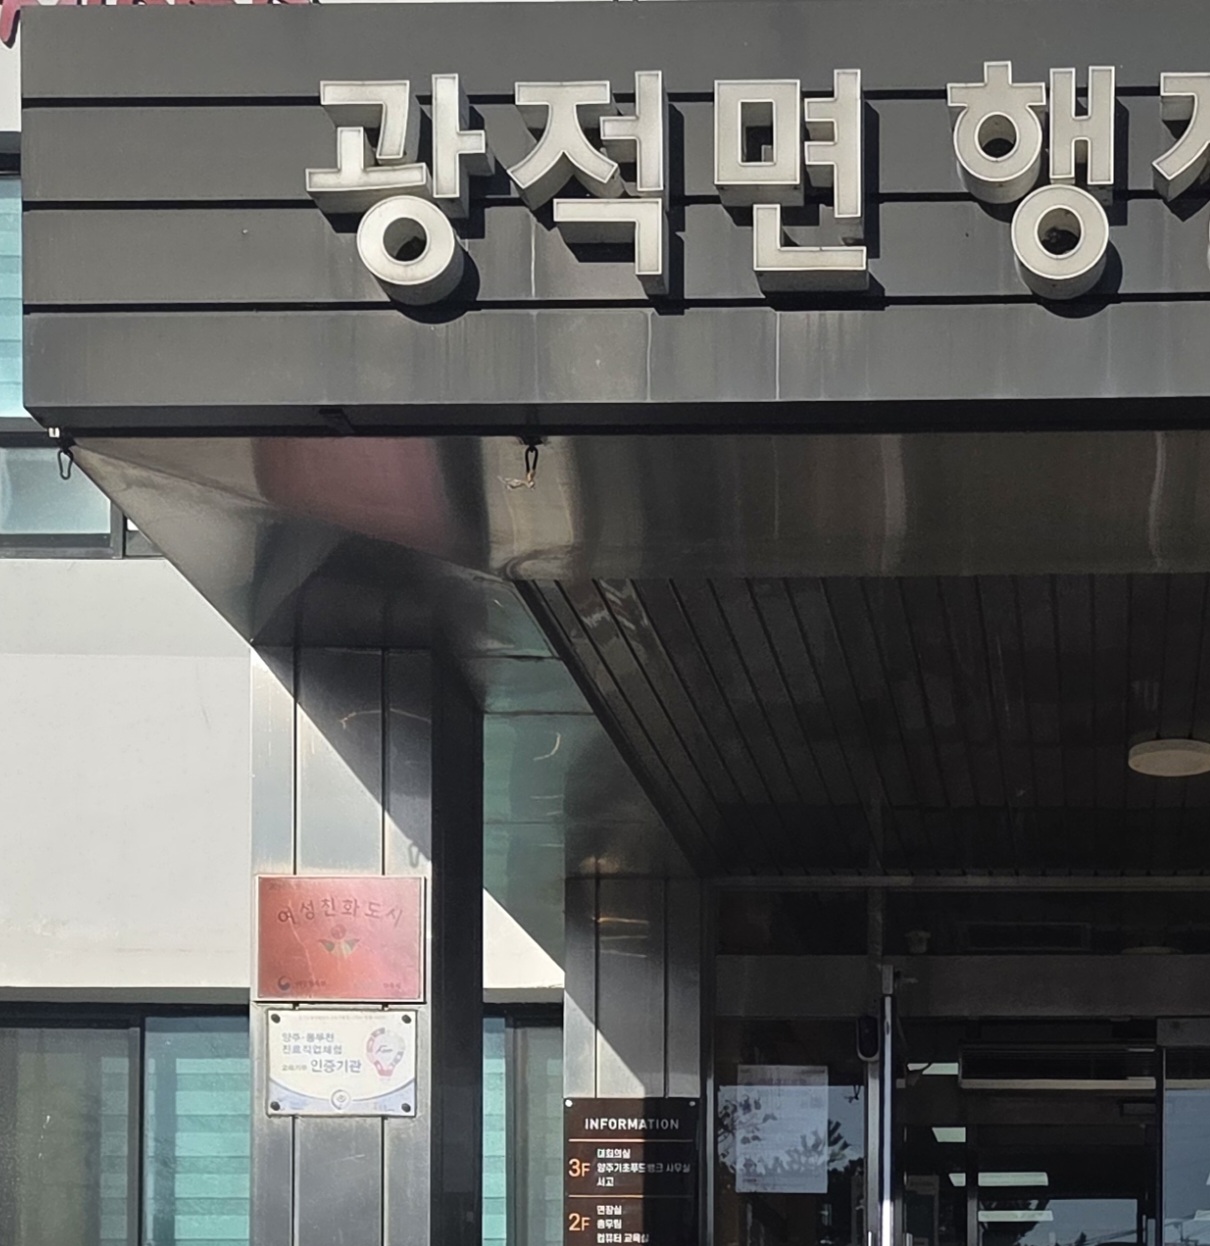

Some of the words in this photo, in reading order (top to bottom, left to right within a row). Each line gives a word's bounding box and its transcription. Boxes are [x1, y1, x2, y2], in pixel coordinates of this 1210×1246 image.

[306, 68, 868, 302] 광적면
[277, 896, 403, 928] 여성친화도시
[311, 1059, 361, 1073] 인증기관
[585, 1117, 680, 1130] INFORMATION
[568, 1158, 591, 1178] 3F
[597, 1163, 664, 1174] 양주기초푸드뱅크
[568, 1213, 591, 1231] 2F
[597, 1233, 623, 1244] 컴퓨터
